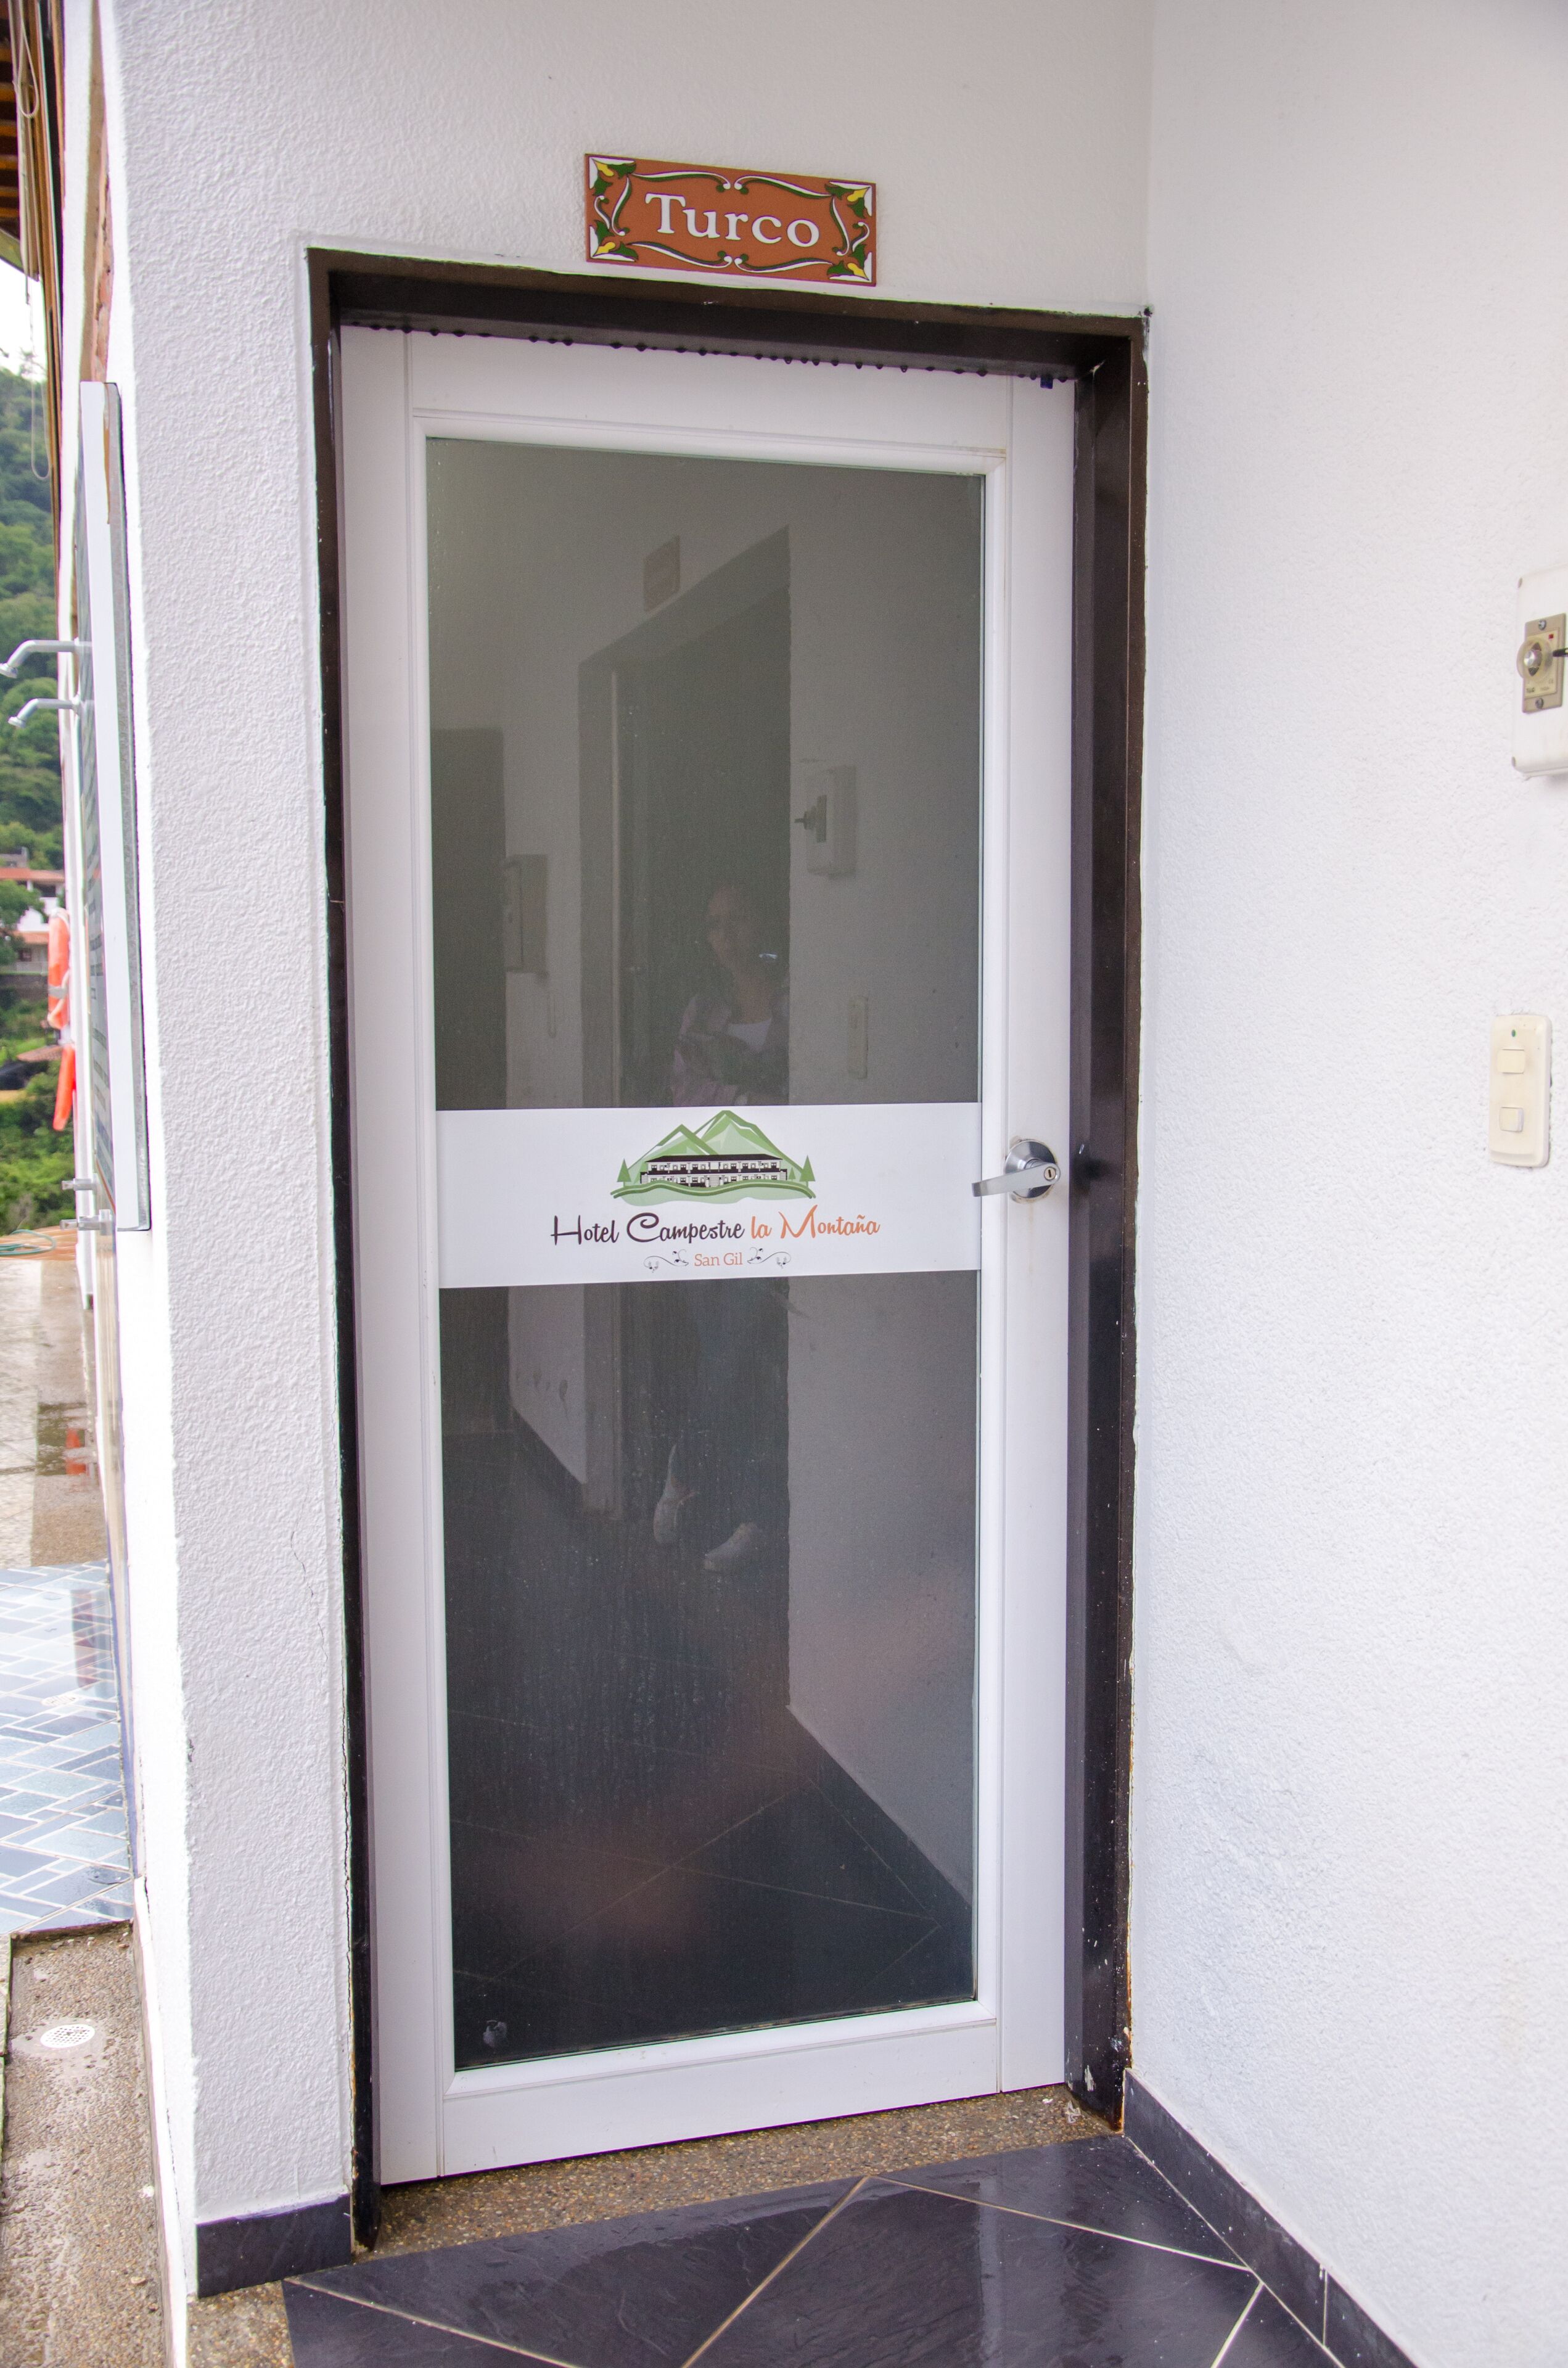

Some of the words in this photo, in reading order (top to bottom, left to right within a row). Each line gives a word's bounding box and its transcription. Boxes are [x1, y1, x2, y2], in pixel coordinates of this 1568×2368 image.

[645, 193, 819, 247] Turco
[551, 1214, 619, 1245] Hotel
[626, 1212, 745, 1244] Campestre
[750, 1216, 772, 1239] la
[779, 1204, 880, 1239] Montaña
[694, 1253, 720, 1267] San
[723, 1252, 743, 1265] Gil
